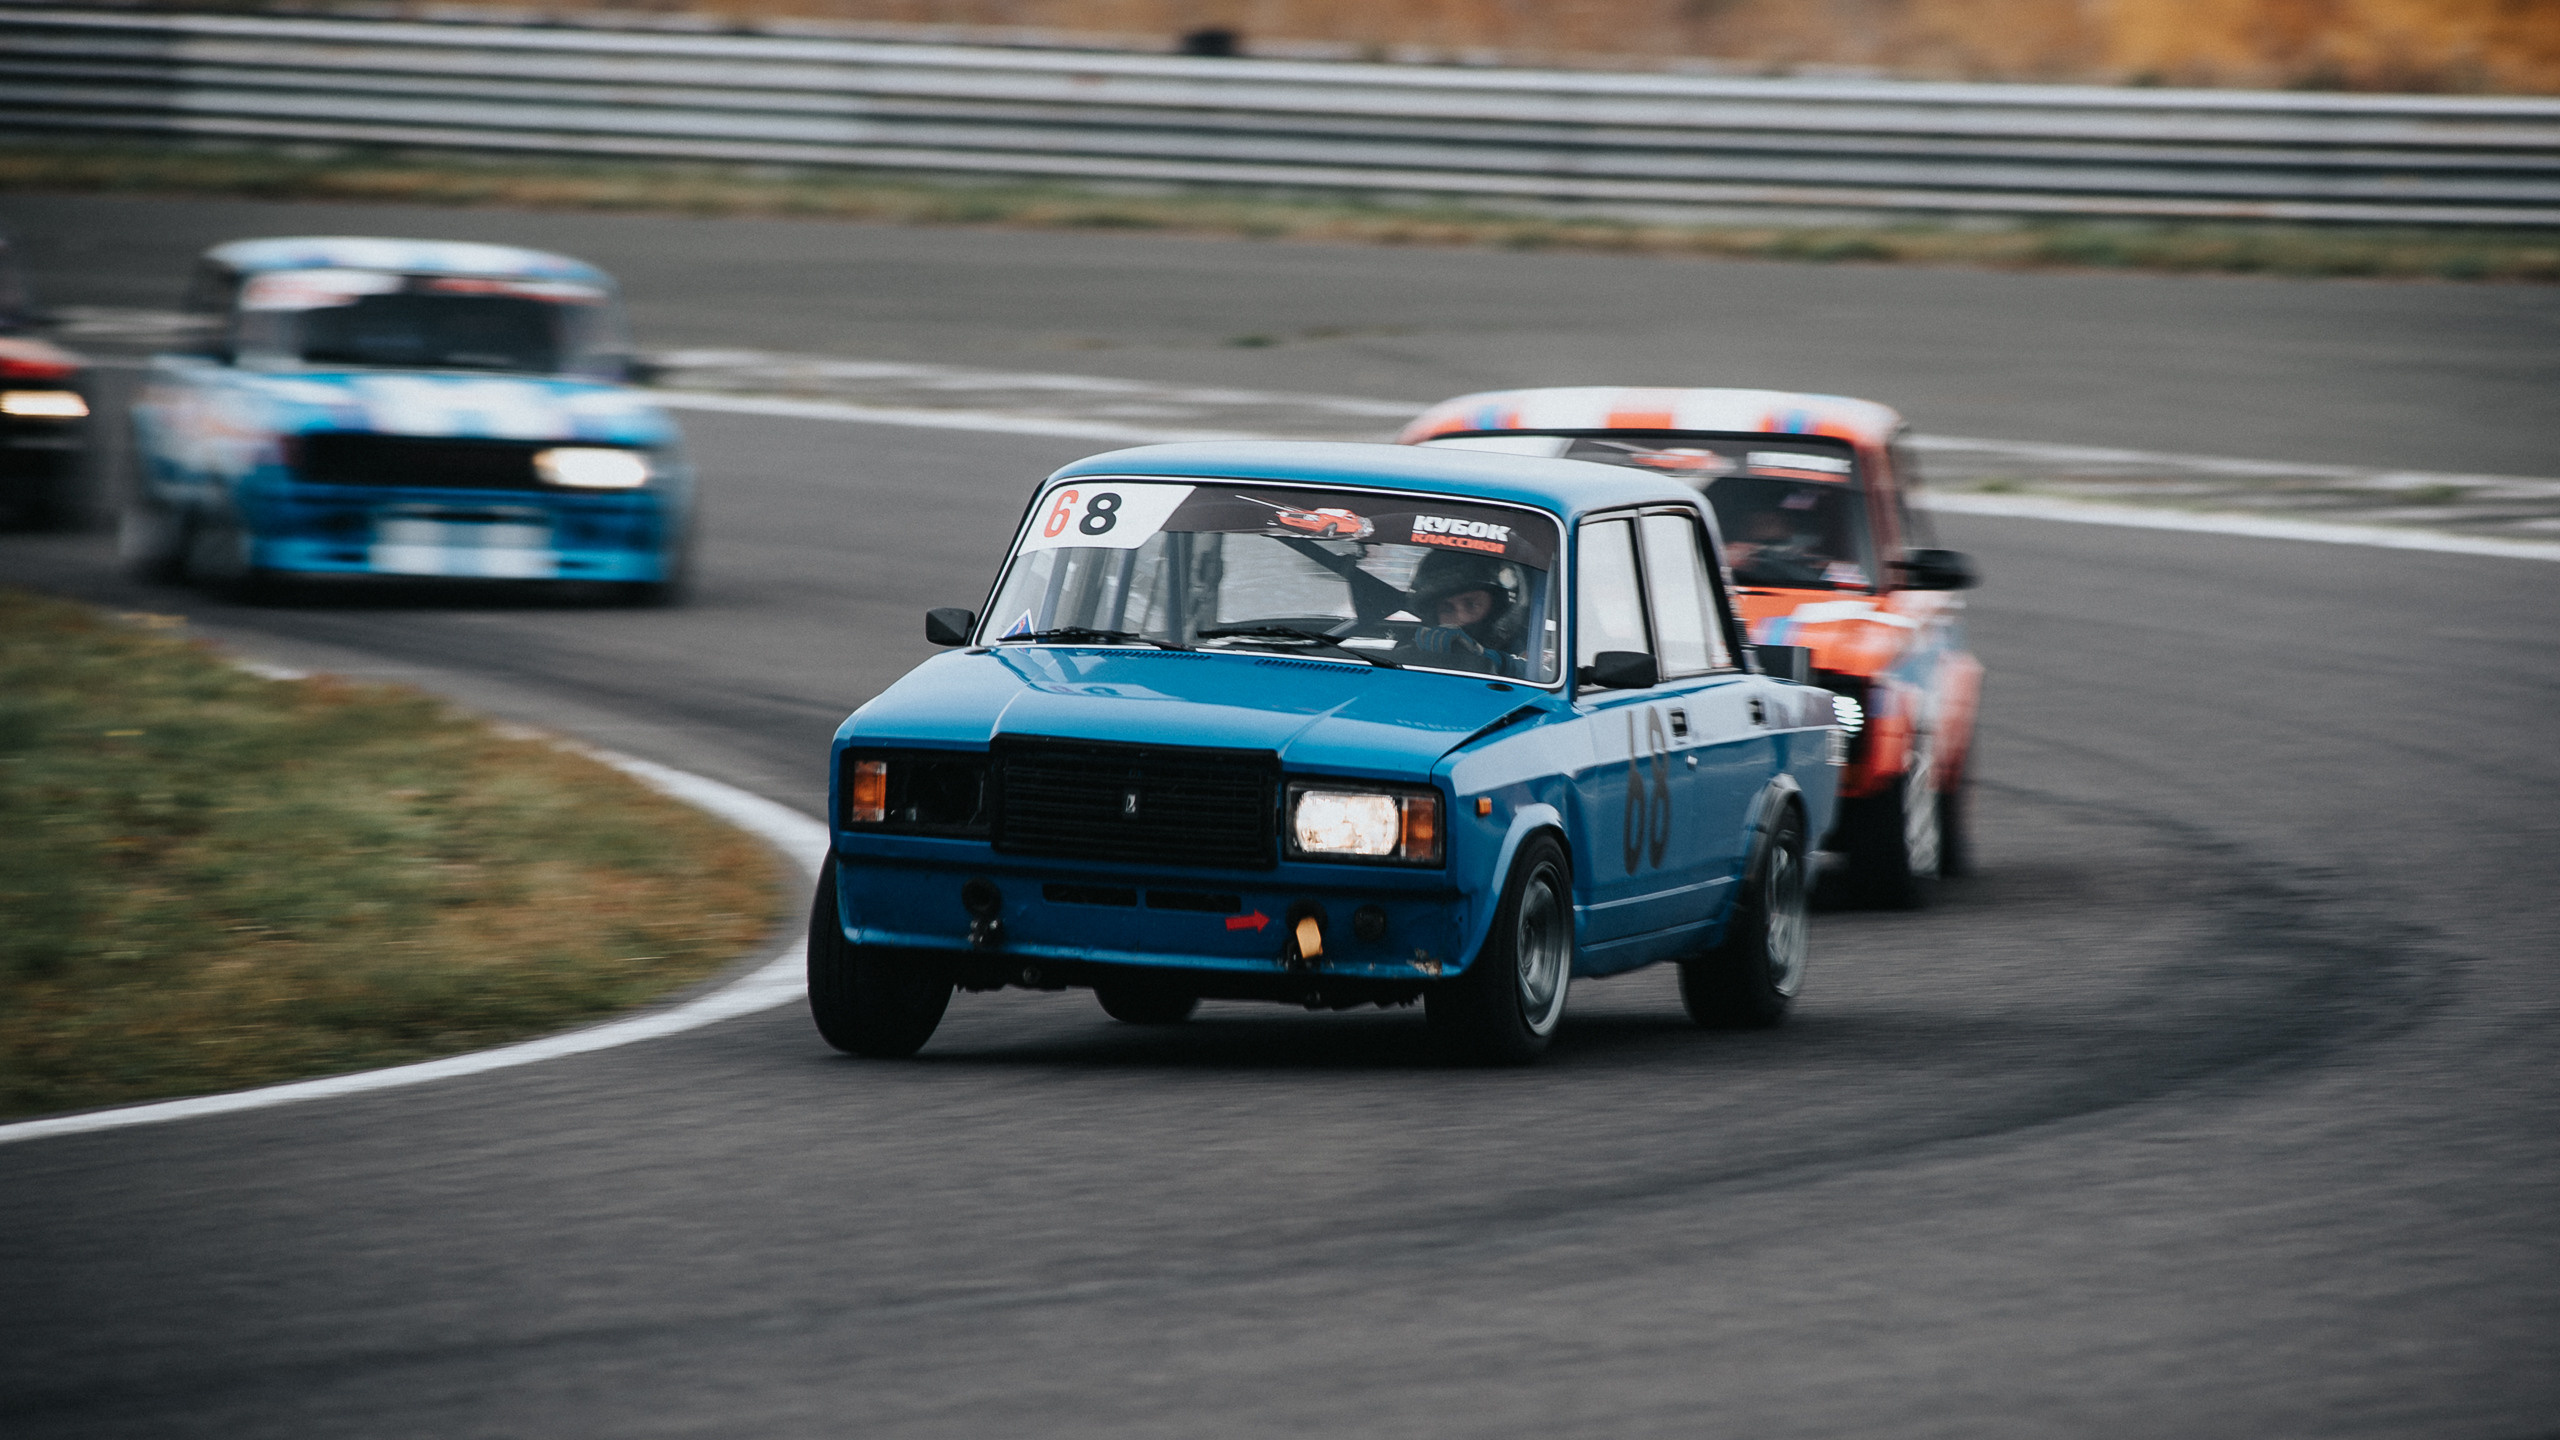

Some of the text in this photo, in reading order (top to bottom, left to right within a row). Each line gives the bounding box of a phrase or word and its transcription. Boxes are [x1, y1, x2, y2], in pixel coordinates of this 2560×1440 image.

[1043, 489, 1122, 538] 68
[1412, 514, 1511, 542] КУБОК
[1623, 705, 1671, 877] 68
